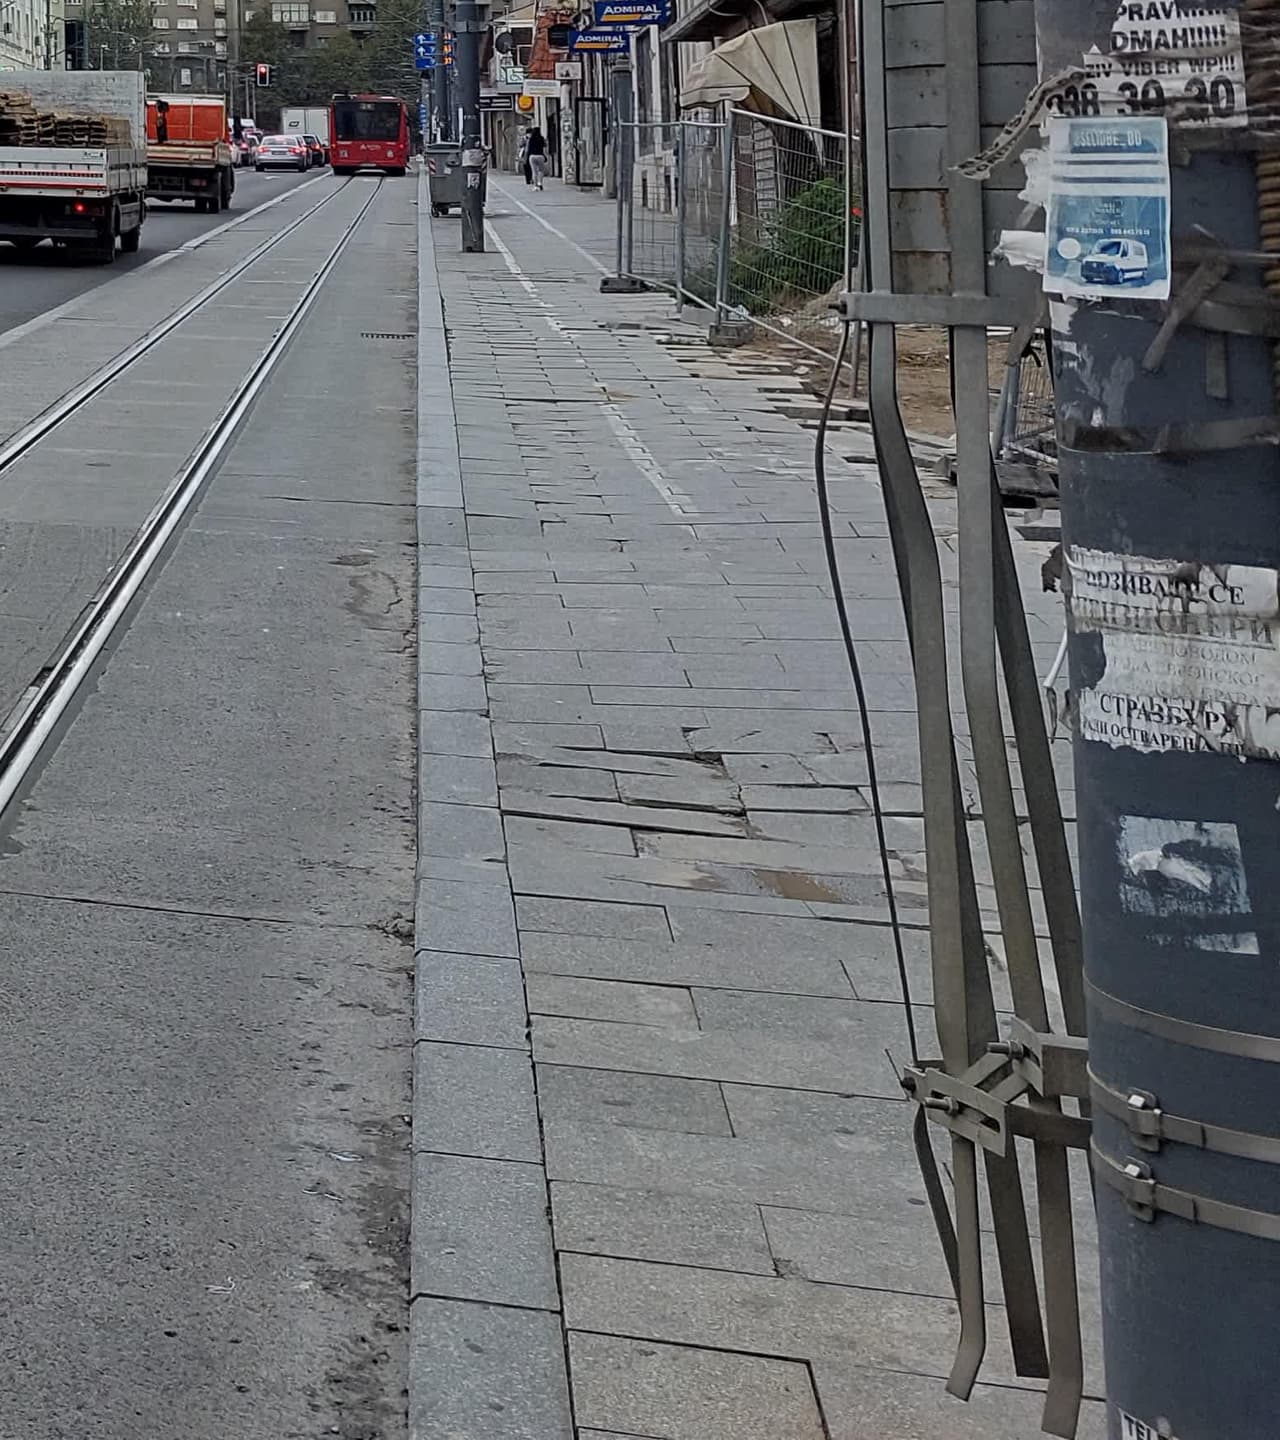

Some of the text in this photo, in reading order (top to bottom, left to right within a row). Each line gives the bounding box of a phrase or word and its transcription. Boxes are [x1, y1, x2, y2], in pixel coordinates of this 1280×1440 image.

[603, 5, 658, 14] ADMIRAL
[576, 35, 624, 43] ADMIRAL
[1119, 58, 1180, 77] VIBER
